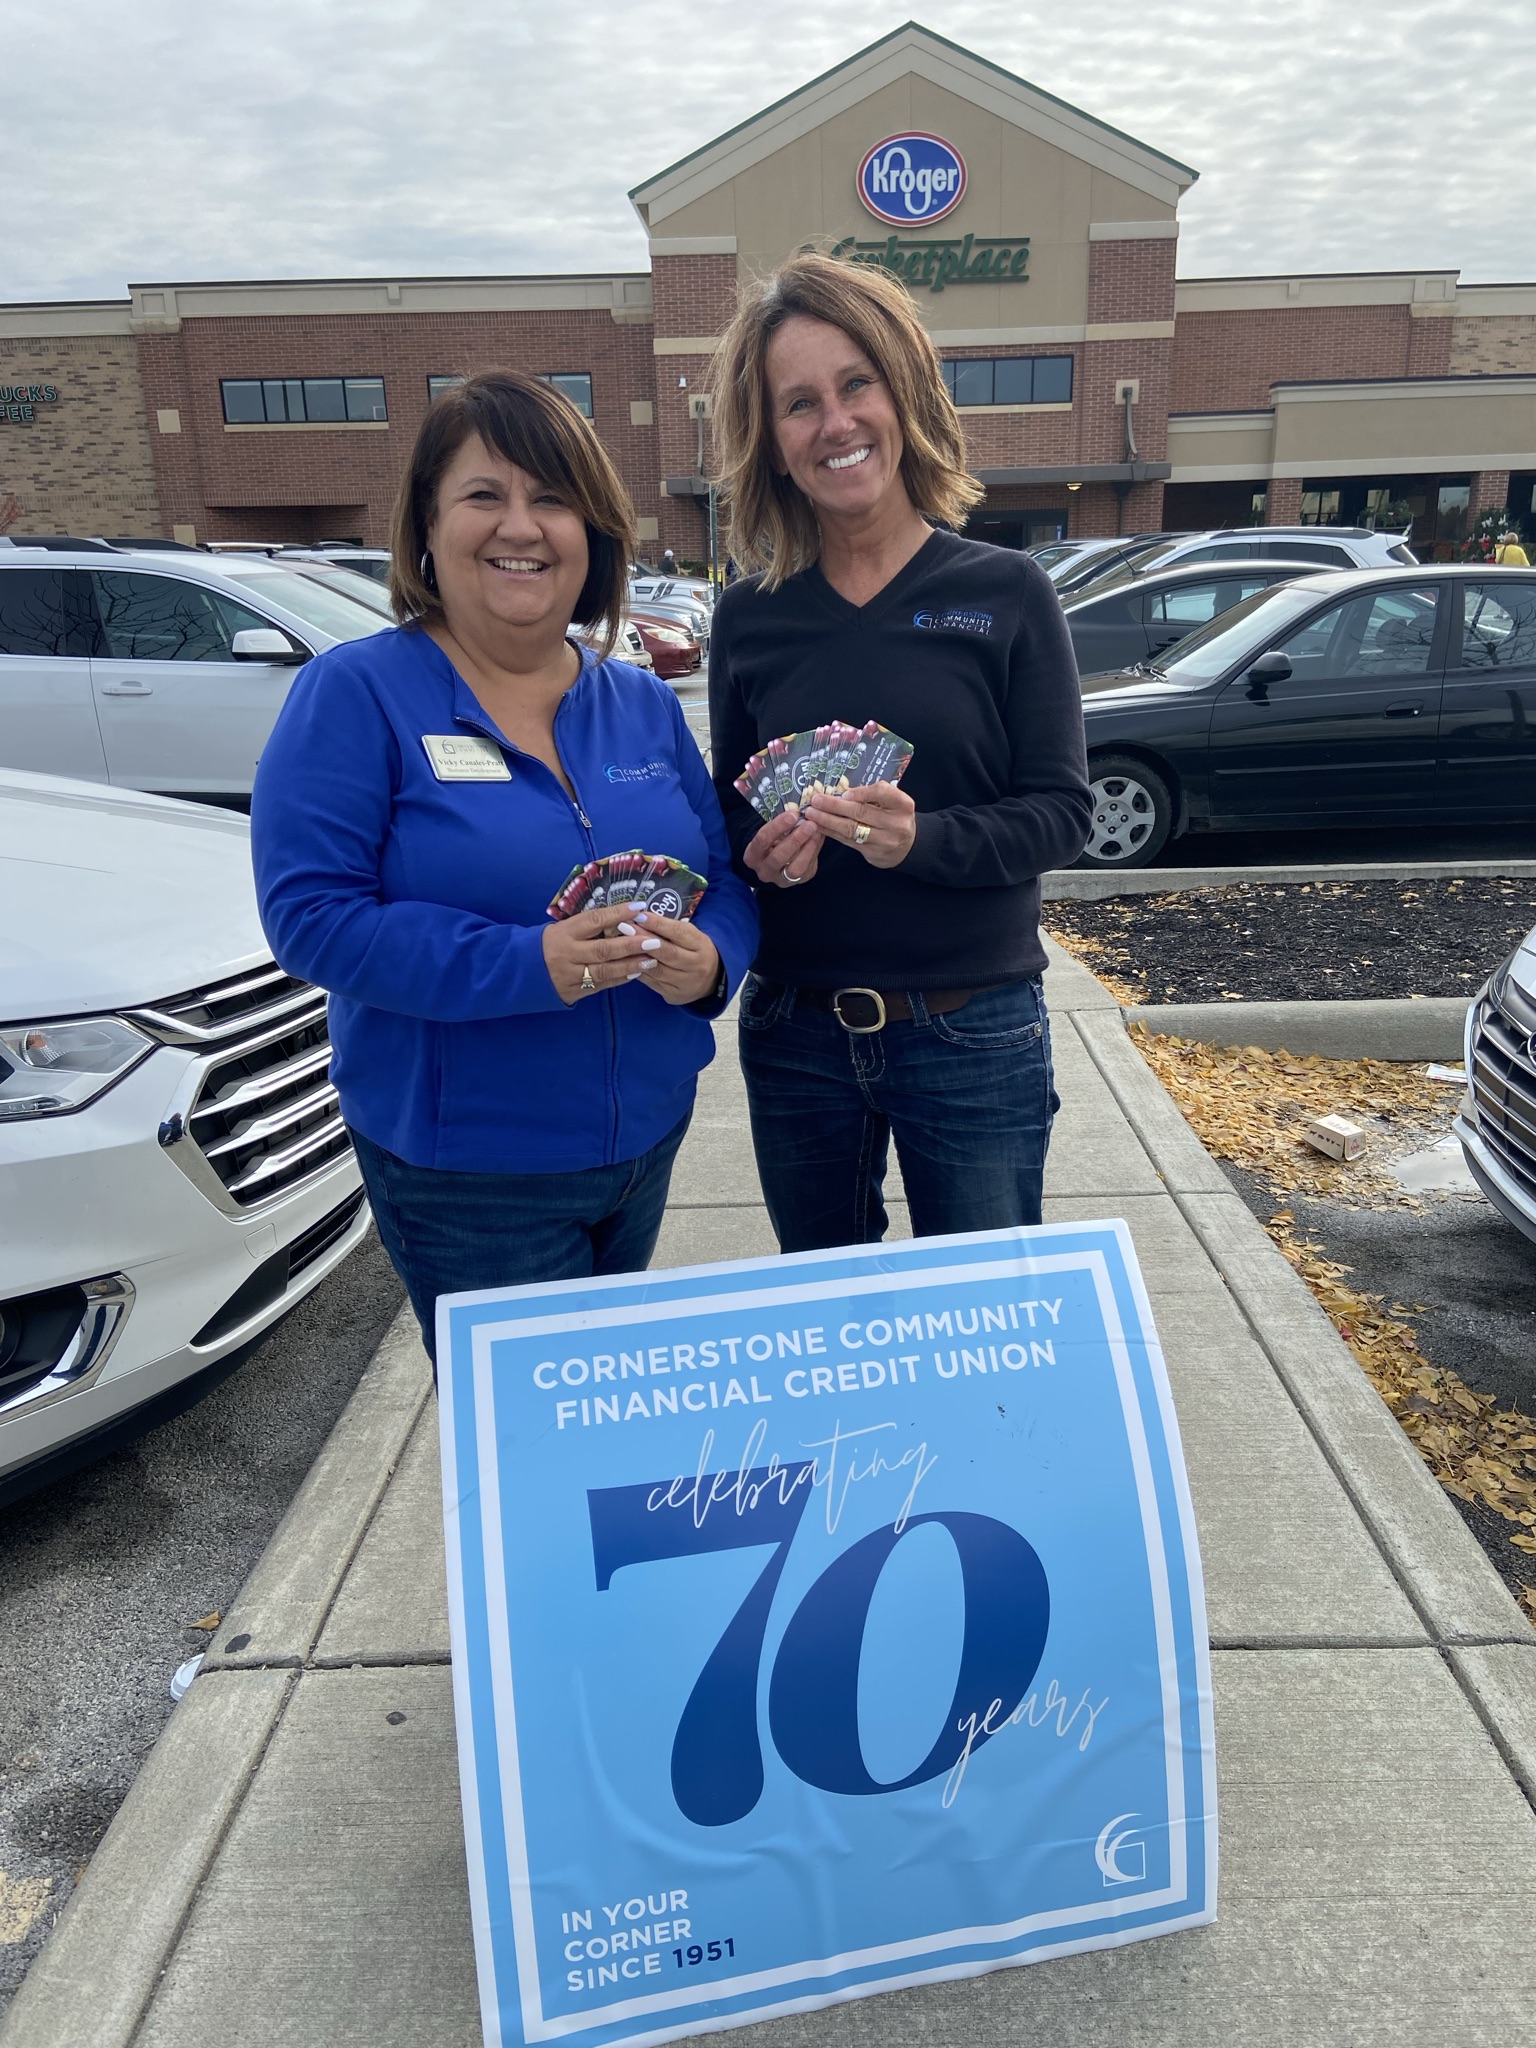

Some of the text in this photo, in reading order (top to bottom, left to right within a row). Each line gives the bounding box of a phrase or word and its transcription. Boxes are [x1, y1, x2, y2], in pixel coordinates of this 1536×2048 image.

[872, 146, 958, 215] Kroger
[533, 1297, 1064, 1390] CORNERSTONE COMMUNITY
[556, 1339, 1057, 1430] FINANCIAL CREDIT UNION
[646, 1419, 938, 1535] celebrating
[586, 1459, 1050, 1827] 70
[942, 1679, 1109, 1809] years
[561, 1889, 689, 1934] IN YOUR
[564, 1918, 692, 1962] CORNER
[567, 1938, 736, 1992] SINCE 1951
